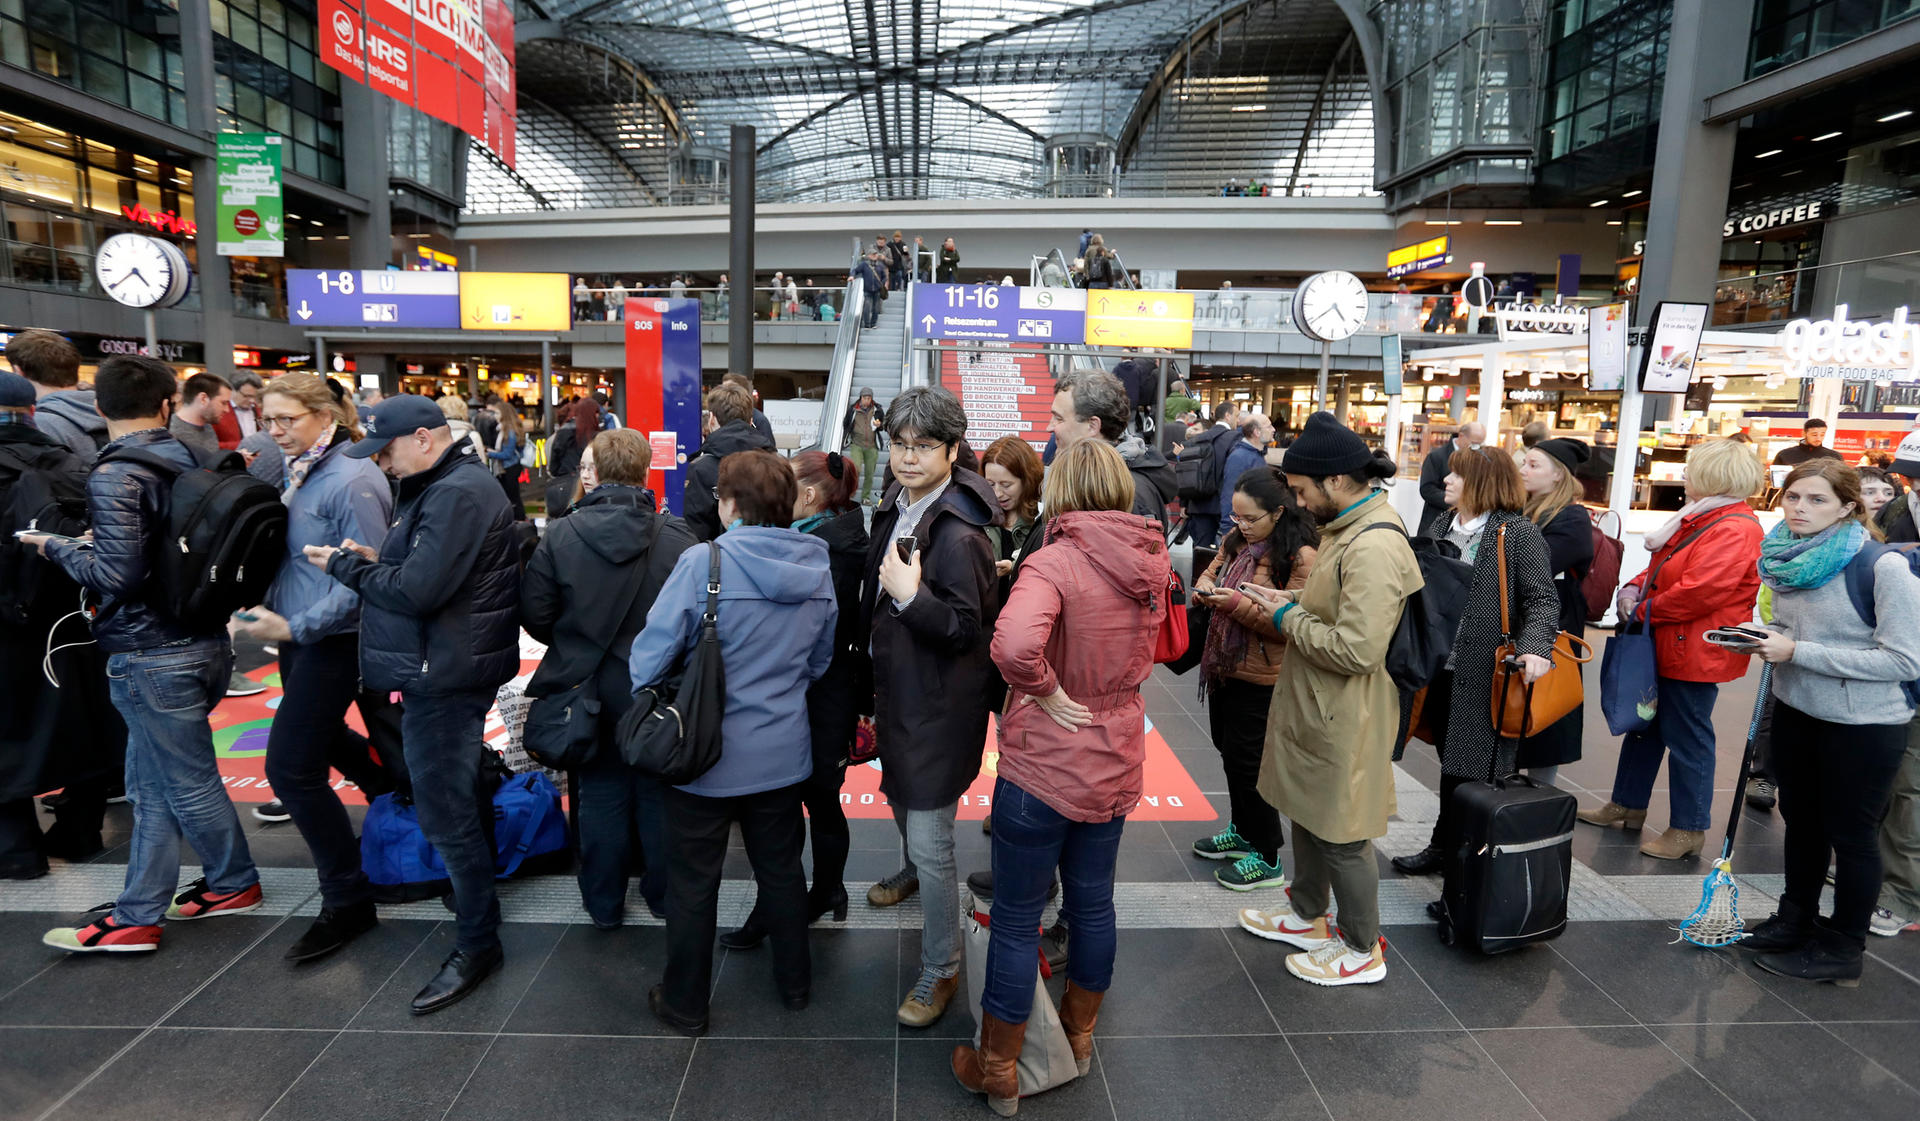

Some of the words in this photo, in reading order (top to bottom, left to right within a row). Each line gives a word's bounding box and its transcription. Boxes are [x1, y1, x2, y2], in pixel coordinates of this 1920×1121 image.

[334, 43, 353, 64] Das
[357, 28, 408, 73] HRS
[1739, 202, 1822, 233] COFFEE
[316, 271, 355, 295] 1-8
[944, 285, 999, 309] 11-16
[634, 320, 654, 330] SOS
[671, 321, 688, 331] Info
[943, 316, 998, 327] Reisezentrum
[100, 339, 138, 355] GOSCH
[1806, 365, 1834, 378] YOUR
[1839, 367, 1867, 380] FOOD
[1871, 368, 1895, 381] BAG
[770, 415, 794, 425] Frisch
[966, 430, 977, 438] OB
